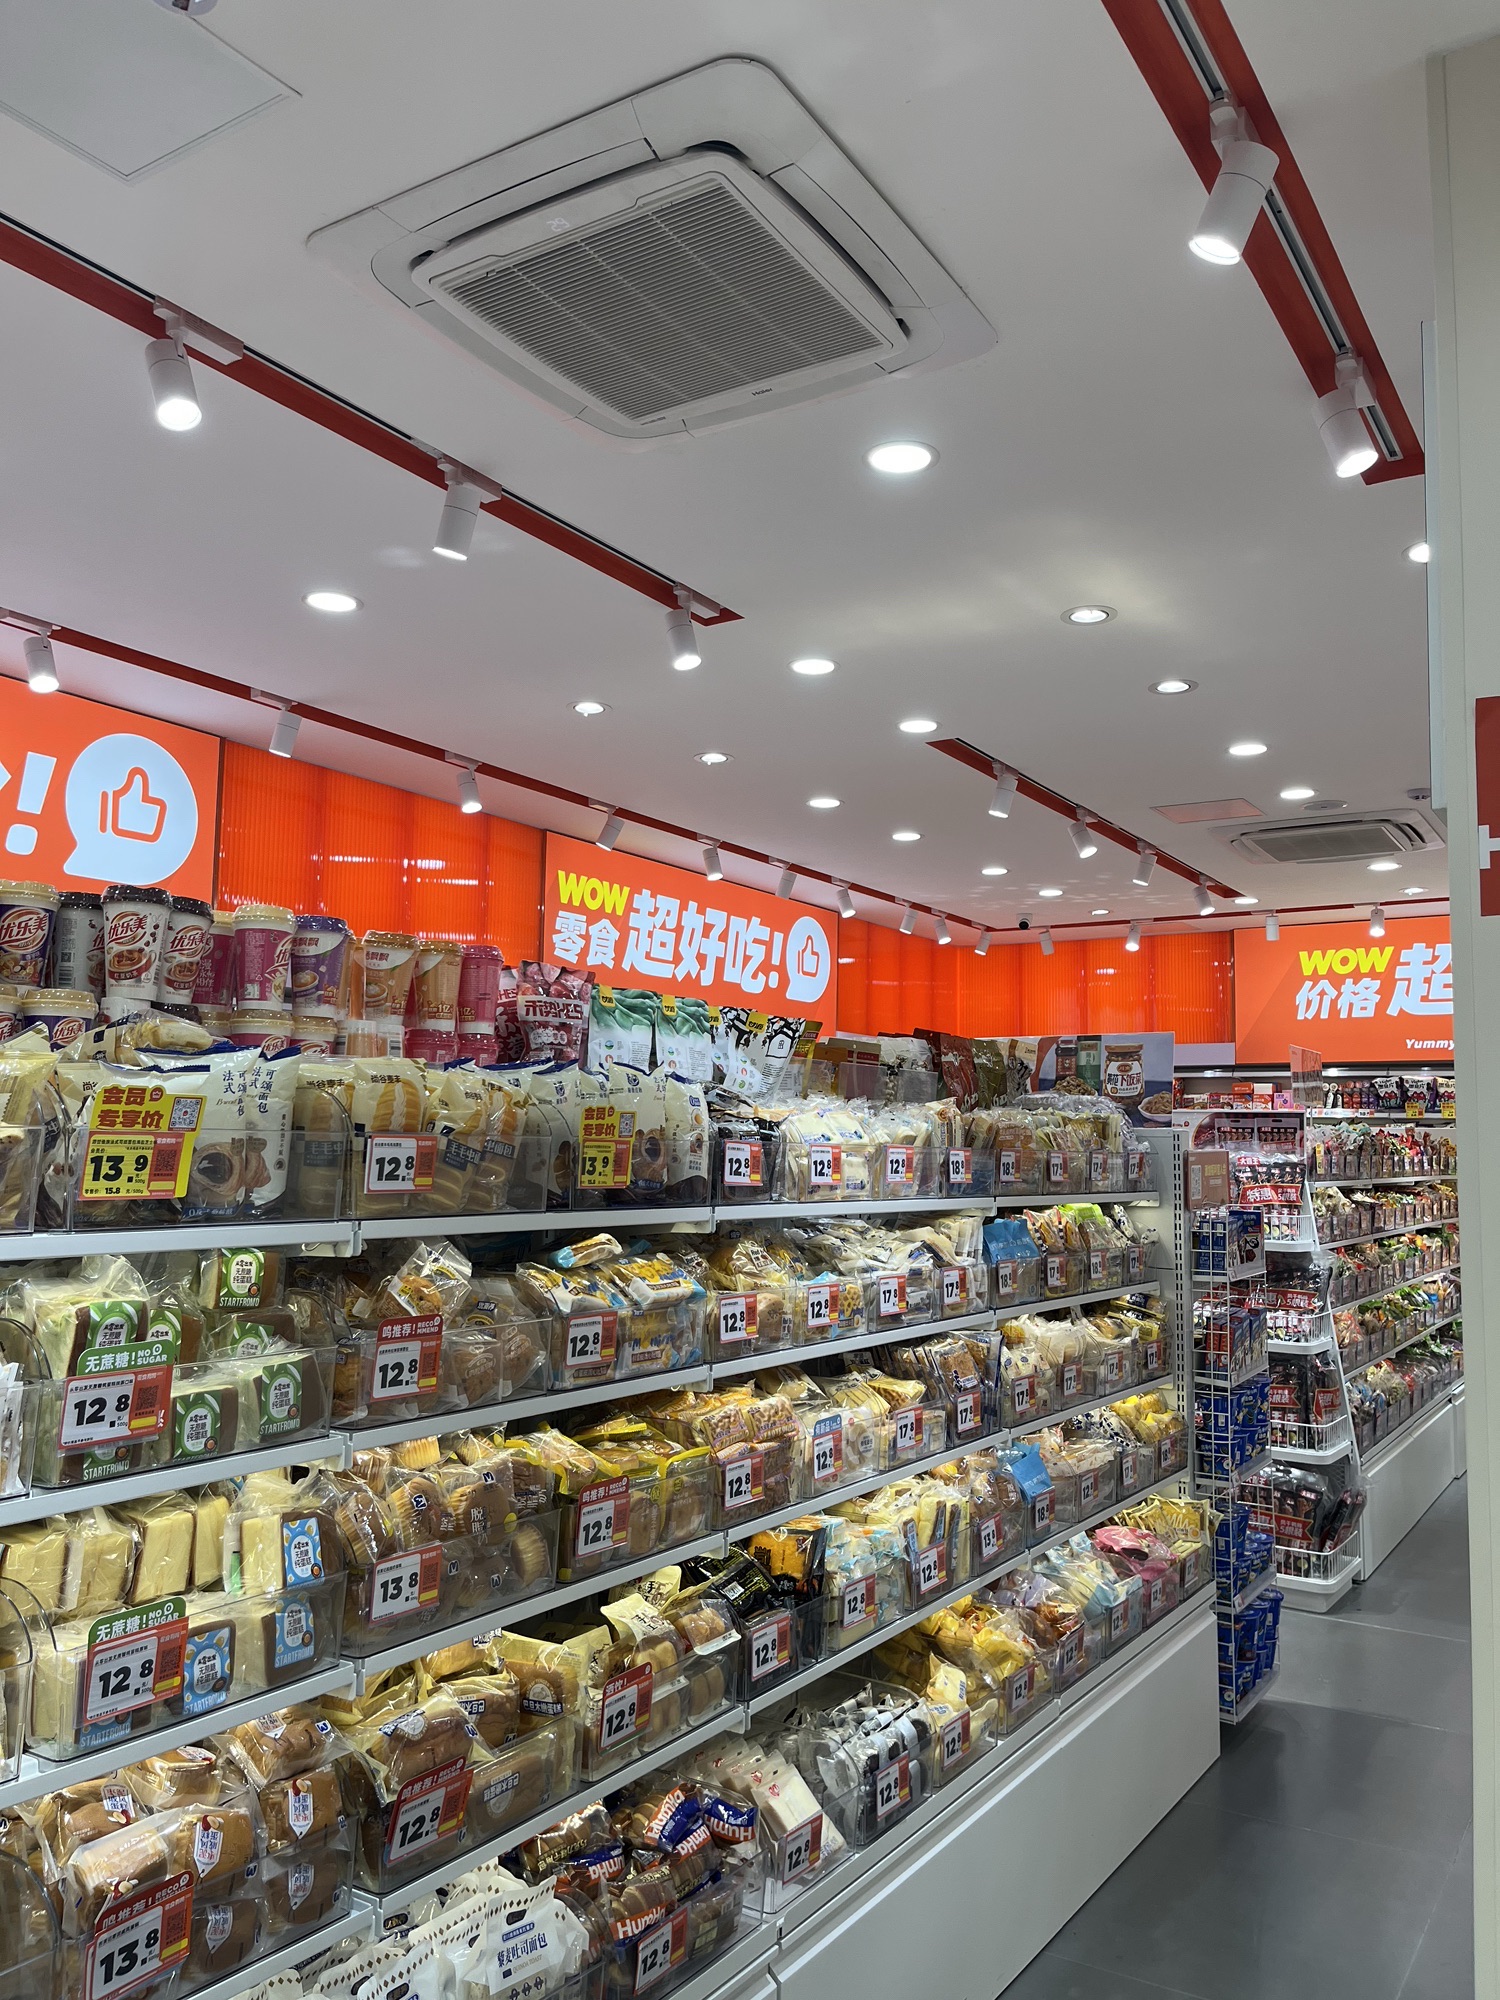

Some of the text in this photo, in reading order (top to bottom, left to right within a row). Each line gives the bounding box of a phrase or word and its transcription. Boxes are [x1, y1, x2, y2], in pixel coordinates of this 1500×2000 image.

[557, 869, 631, 917] WOW
[107, 914, 149, 939] 优乐美
[552, 911, 621, 970] 零食
[621, 887, 784, 995] 超好吃!
[1299, 946, 1394, 976] WOW
[1295, 977, 1381, 1020] 价格
[222, 1070, 236, 1095] 法式
[249, 1066, 263, 1089] 法式
[102, 1087, 146, 1106] 会员
[257, 1068, 277, 1114] 可颂面包
[96, 1109, 164, 1129] 专享价
[584, 1106, 606, 1120] 会员
[582, 1123, 616, 1137] 专享价
[90, 1154, 149, 1183] 13.9
[375, 1156, 415, 1182] 12.8
[728, 1157, 750, 1177] 12.8
[813, 1160, 831, 1177] 12.8
[889, 1158, 906, 1174] 12.8
[951, 1160, 964, 1175] 18.8
[104, 1187, 121, 1195] 15.8
[232, 1275, 253, 1284] 纯蛋糕
[945, 1280, 959, 1298] 17.8
[810, 1299, 829, 1319] 12.8
[883, 1288, 898, 1306] 17.8
[382, 1323, 415, 1338] 鸣推荐!
[723, 1311, 745, 1333] 12.8
[137, 1349, 151, 1357] NO
[569, 1332, 599, 1358] 12.8
[85, 1351, 135, 1374] 无蔗糖!
[137, 1354, 167, 1366] SUGAR
[379, 1358, 418, 1389] 12.8
[74, 1394, 131, 1427] 12.8
[899, 1422, 914, 1440] 17.8
[816, 1448, 833, 1472] 12.8
[583, 1487, 608, 1502] 鸣推荐!
[728, 1472, 750, 1499] 12.8
[583, 1516, 612, 1546] 12.8
[922, 1560, 938, 1584] 12.8
[380, 1571, 418, 1603] 13.8
[149, 1609, 162, 1618] NO
[847, 1593, 865, 1615] 12.8
[95, 1614, 147, 1643] 无蔗糖!
[149, 1612, 179, 1627] SUGAR
[755, 1638, 776, 1668] 12.8
[99, 1659, 154, 1699] 12.8
[606, 1702, 635, 1738] 12.8
[945, 1732, 961, 1758] 12.8
[879, 1777, 898, 1807] 12.8
[399, 1806, 440, 1849] 12.8
[787, 1839, 810, 1872] 12.8
[156, 1882, 179, 1899] RECO
[99, 1928, 159, 1985] 13.8
[641, 1939, 670, 1976] 12.8
